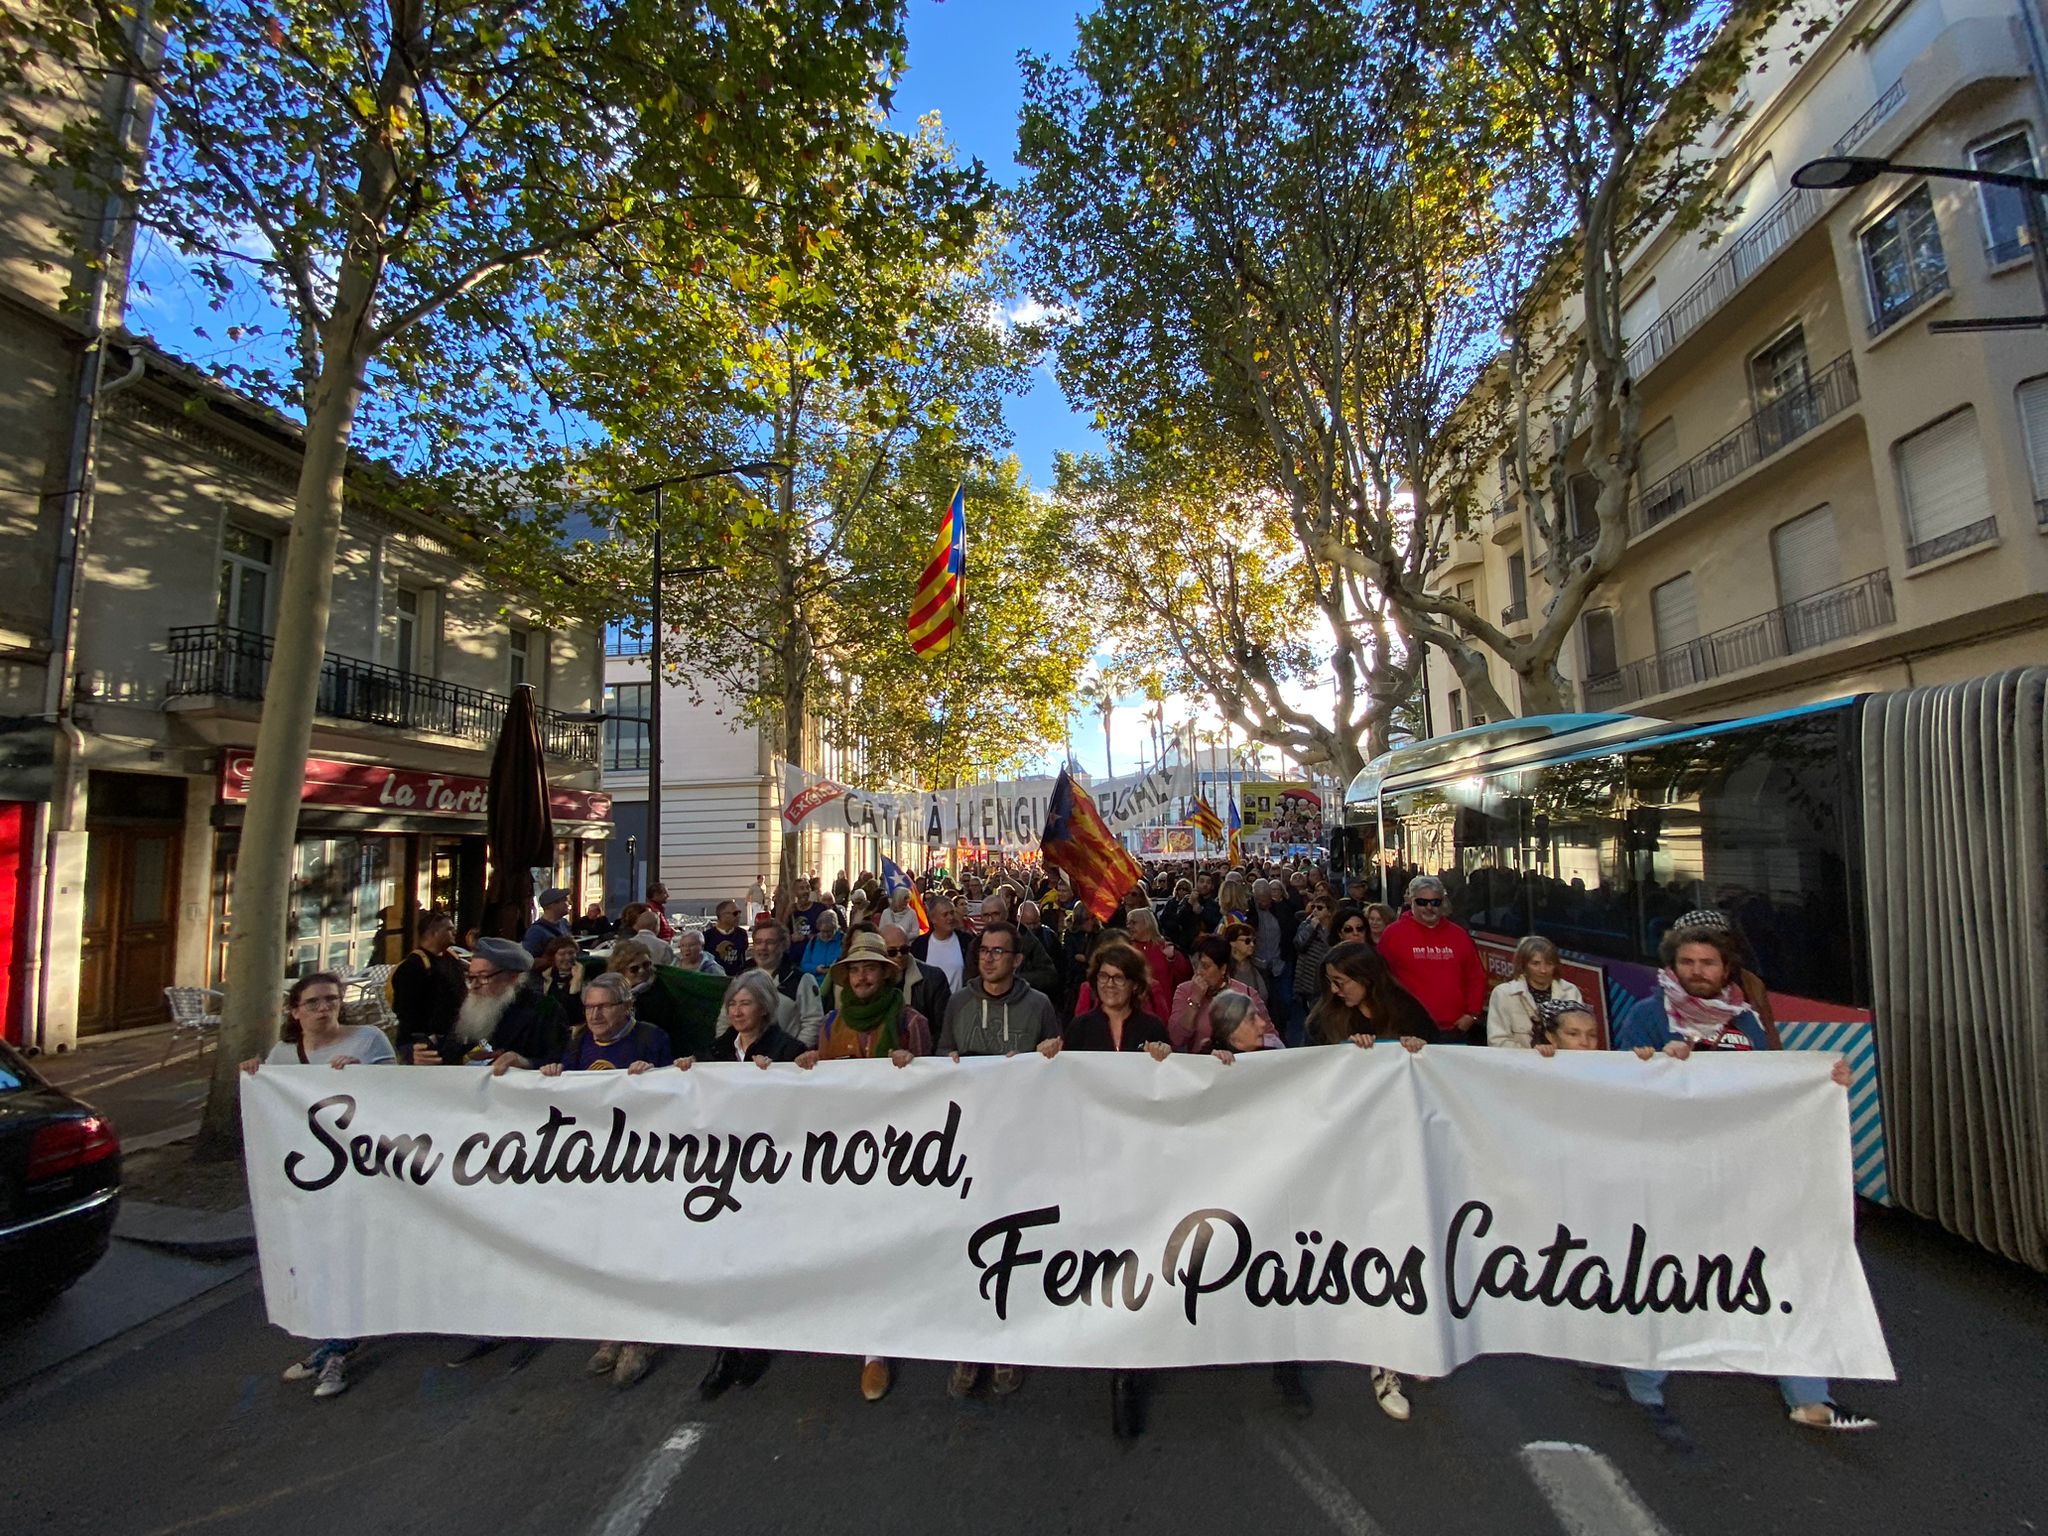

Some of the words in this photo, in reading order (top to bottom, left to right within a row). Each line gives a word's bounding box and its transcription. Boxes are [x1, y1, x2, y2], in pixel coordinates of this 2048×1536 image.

[380, 773, 417, 808] La
[425, 779, 489, 813] Tarti
[956, 796, 1048, 845] LLENGU
[284, 1094, 443, 1192] Sem
[452, 1105, 792, 1223] catalunya
[802, 1100, 973, 1200] nord,
[967, 1205, 1153, 1321] Fem
[1162, 1207, 1429, 1326] Països
[1444, 1199, 1794, 1319] Catalans.
